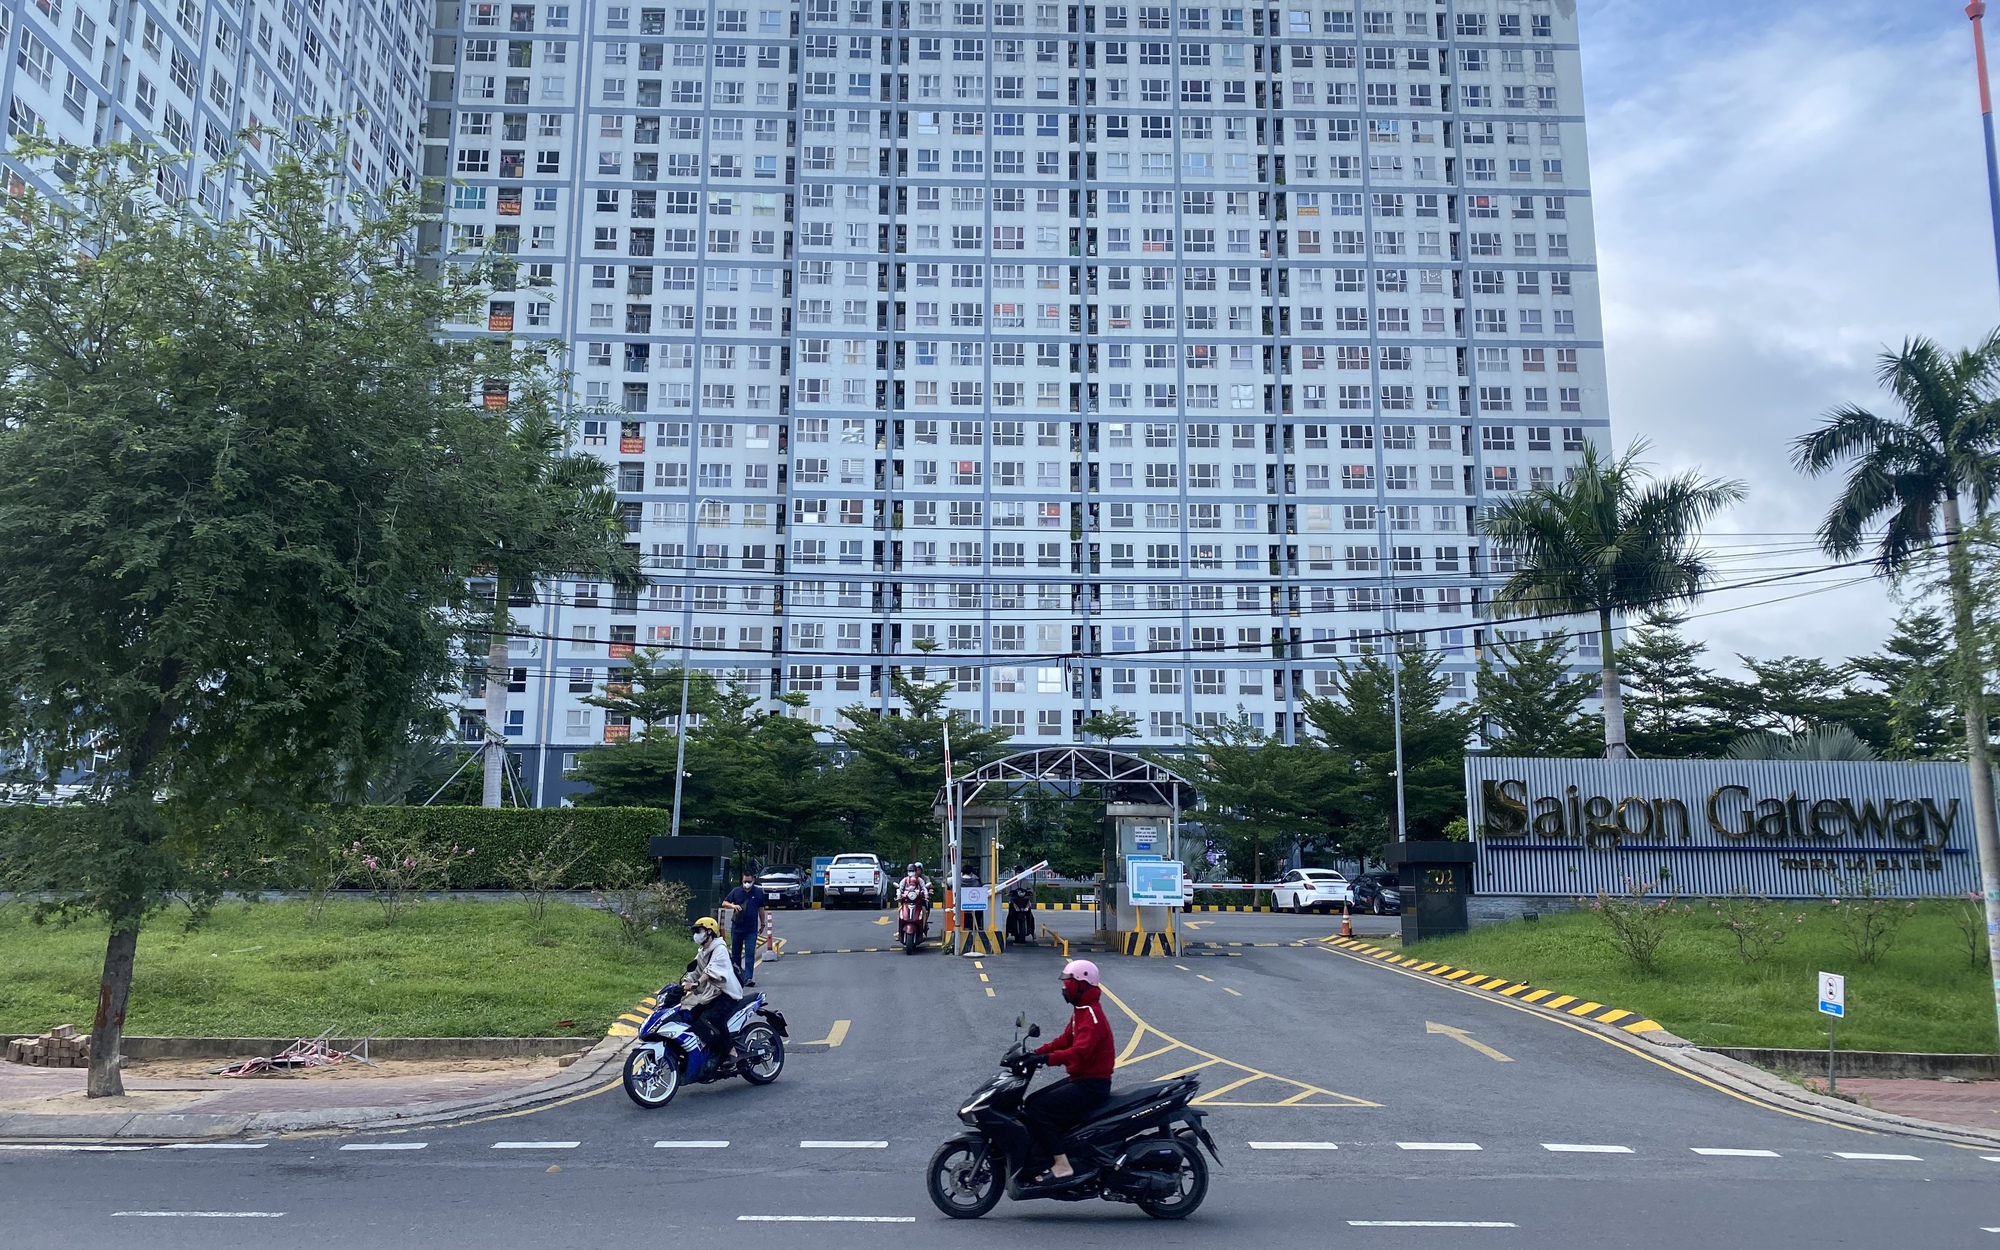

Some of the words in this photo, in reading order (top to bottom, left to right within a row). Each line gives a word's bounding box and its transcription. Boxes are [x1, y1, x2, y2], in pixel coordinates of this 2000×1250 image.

[1483, 779, 1692, 850] Saigon
[1707, 784, 1960, 851] Gateway
[1426, 869, 1454, 885] 702
